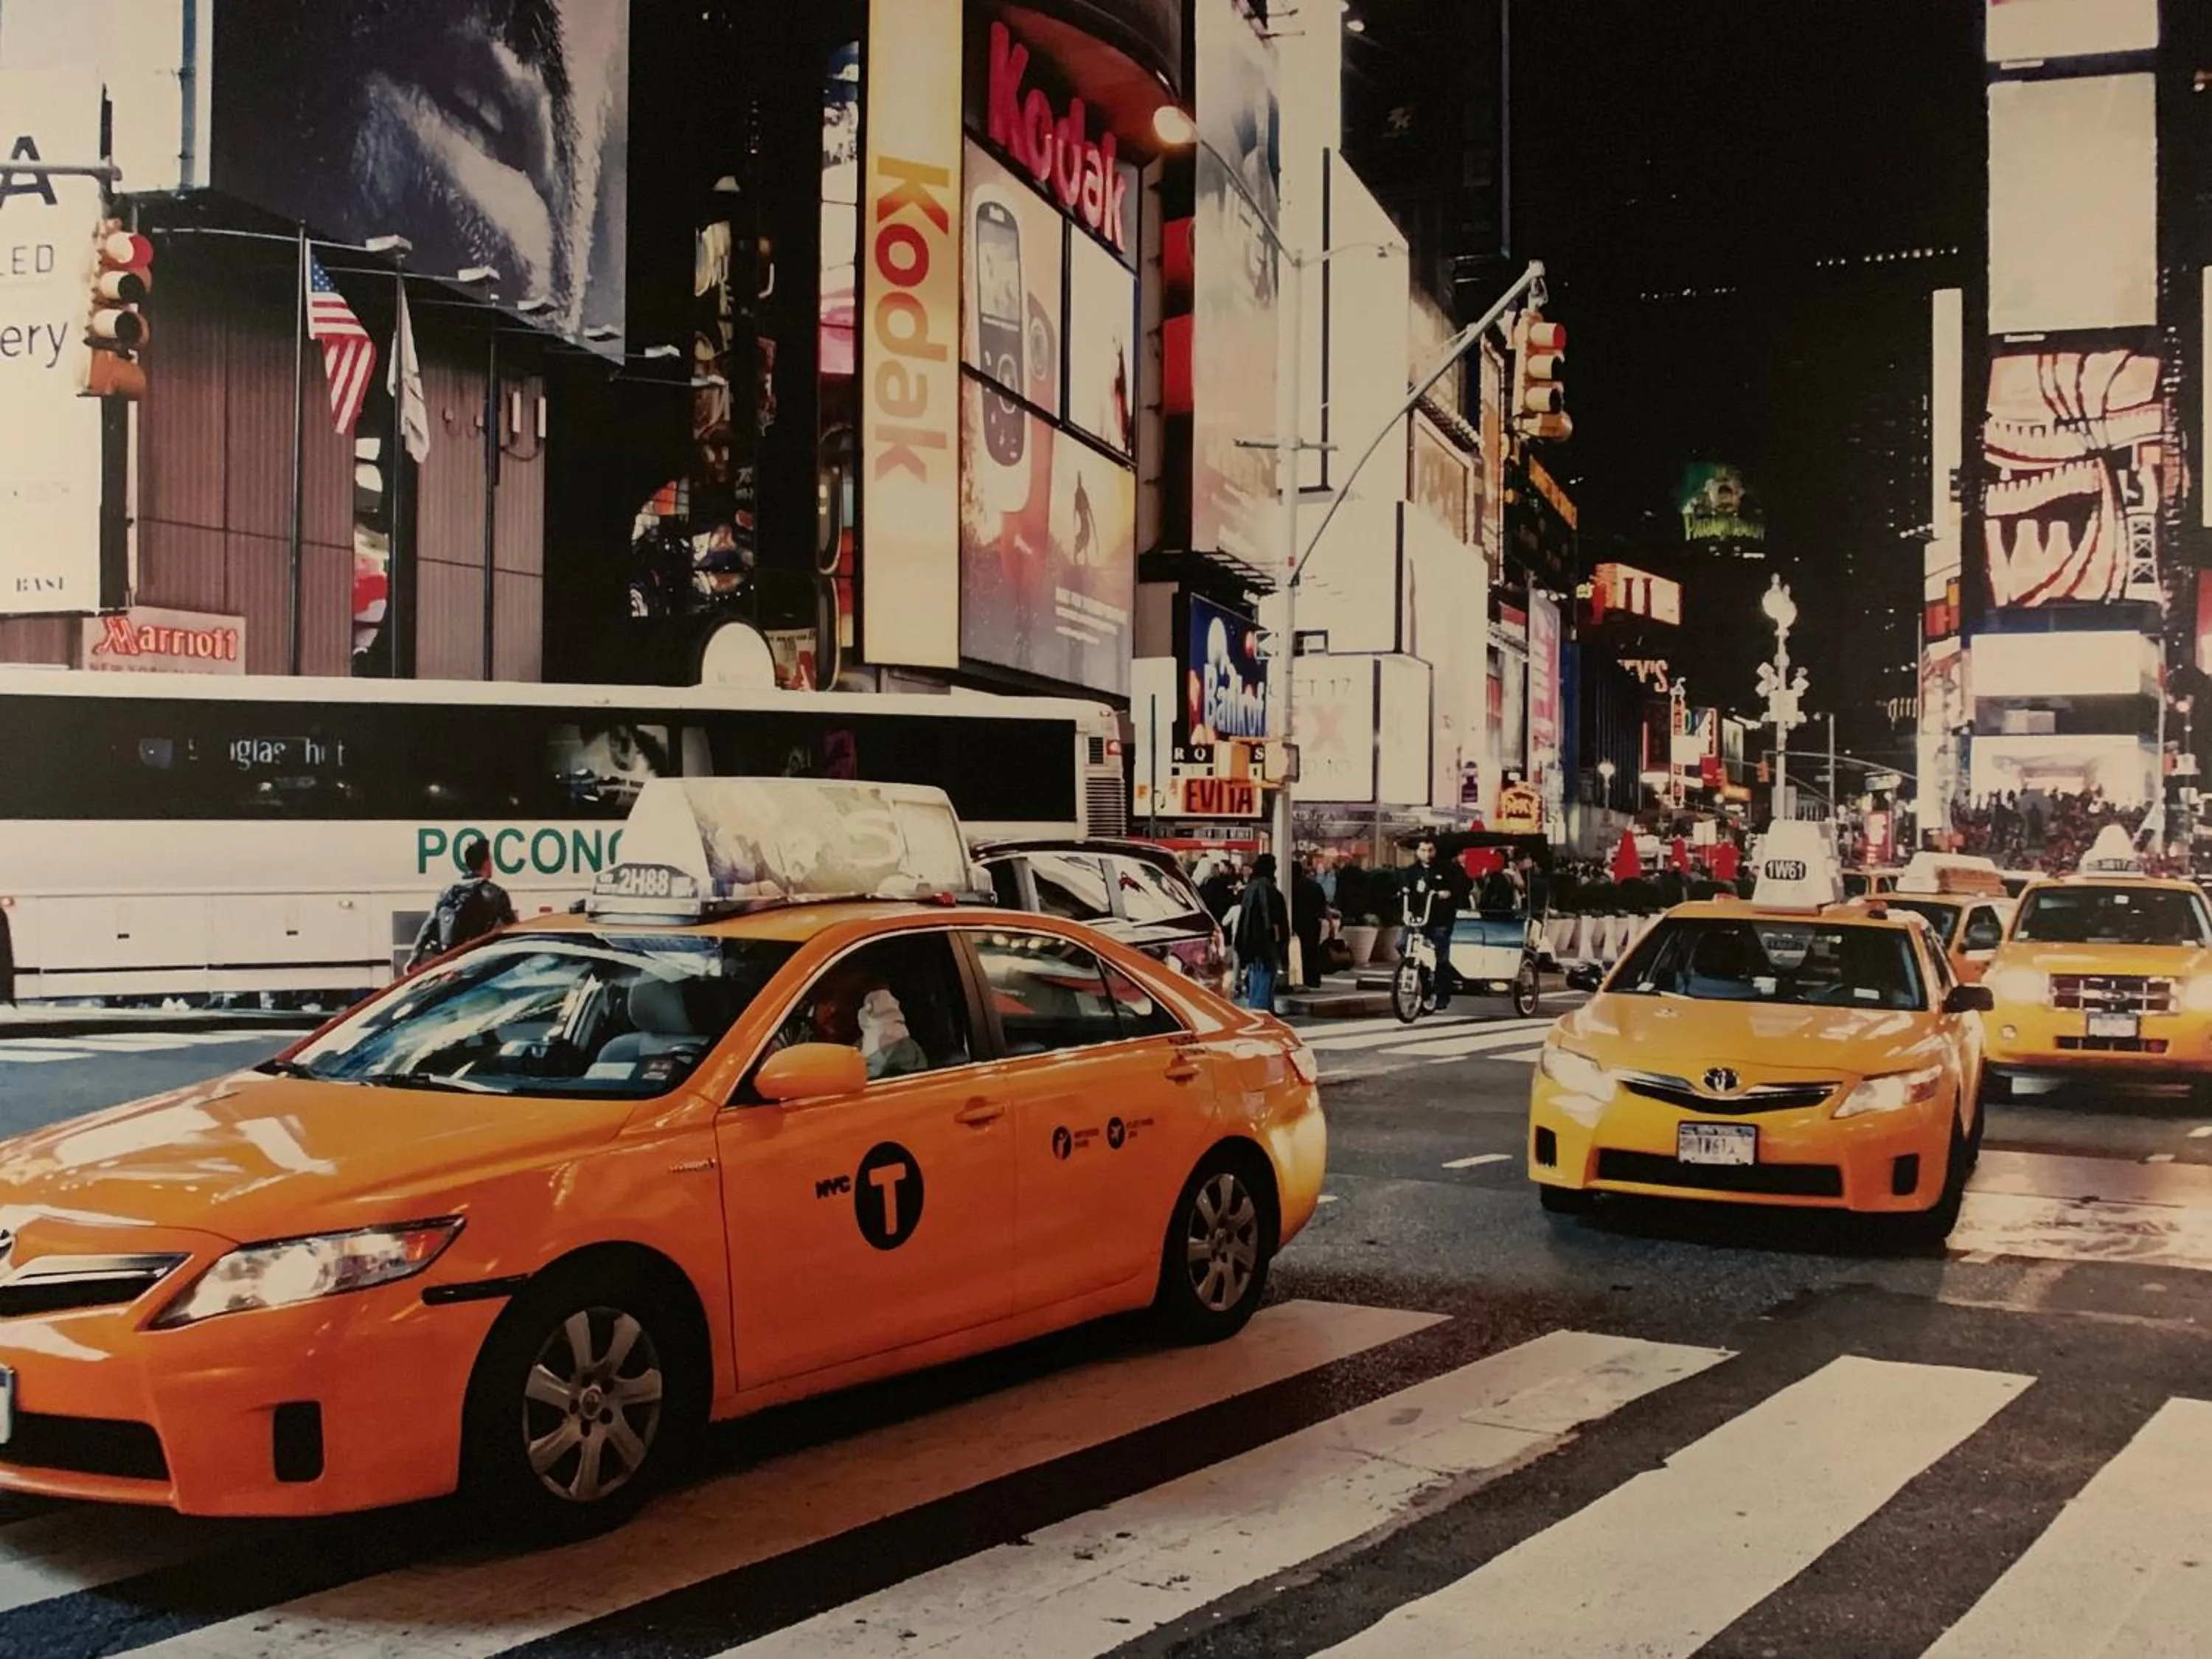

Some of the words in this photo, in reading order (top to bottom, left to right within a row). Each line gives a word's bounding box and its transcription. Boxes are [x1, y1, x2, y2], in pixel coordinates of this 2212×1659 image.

[989, 21, 1126, 254] Kodak
[0, 244, 54, 276] ED
[874, 156, 950, 484] Kodak
[1, 321, 68, 369] ery
[91, 614, 239, 661] Marriott
[1184, 779, 1253, 814] EVITA
[619, 867, 669, 897] 2H88
[1767, 860, 1804, 879] 1W61
[815, 1175, 852, 1200] NYC
[869, 1161, 907, 1237] T
